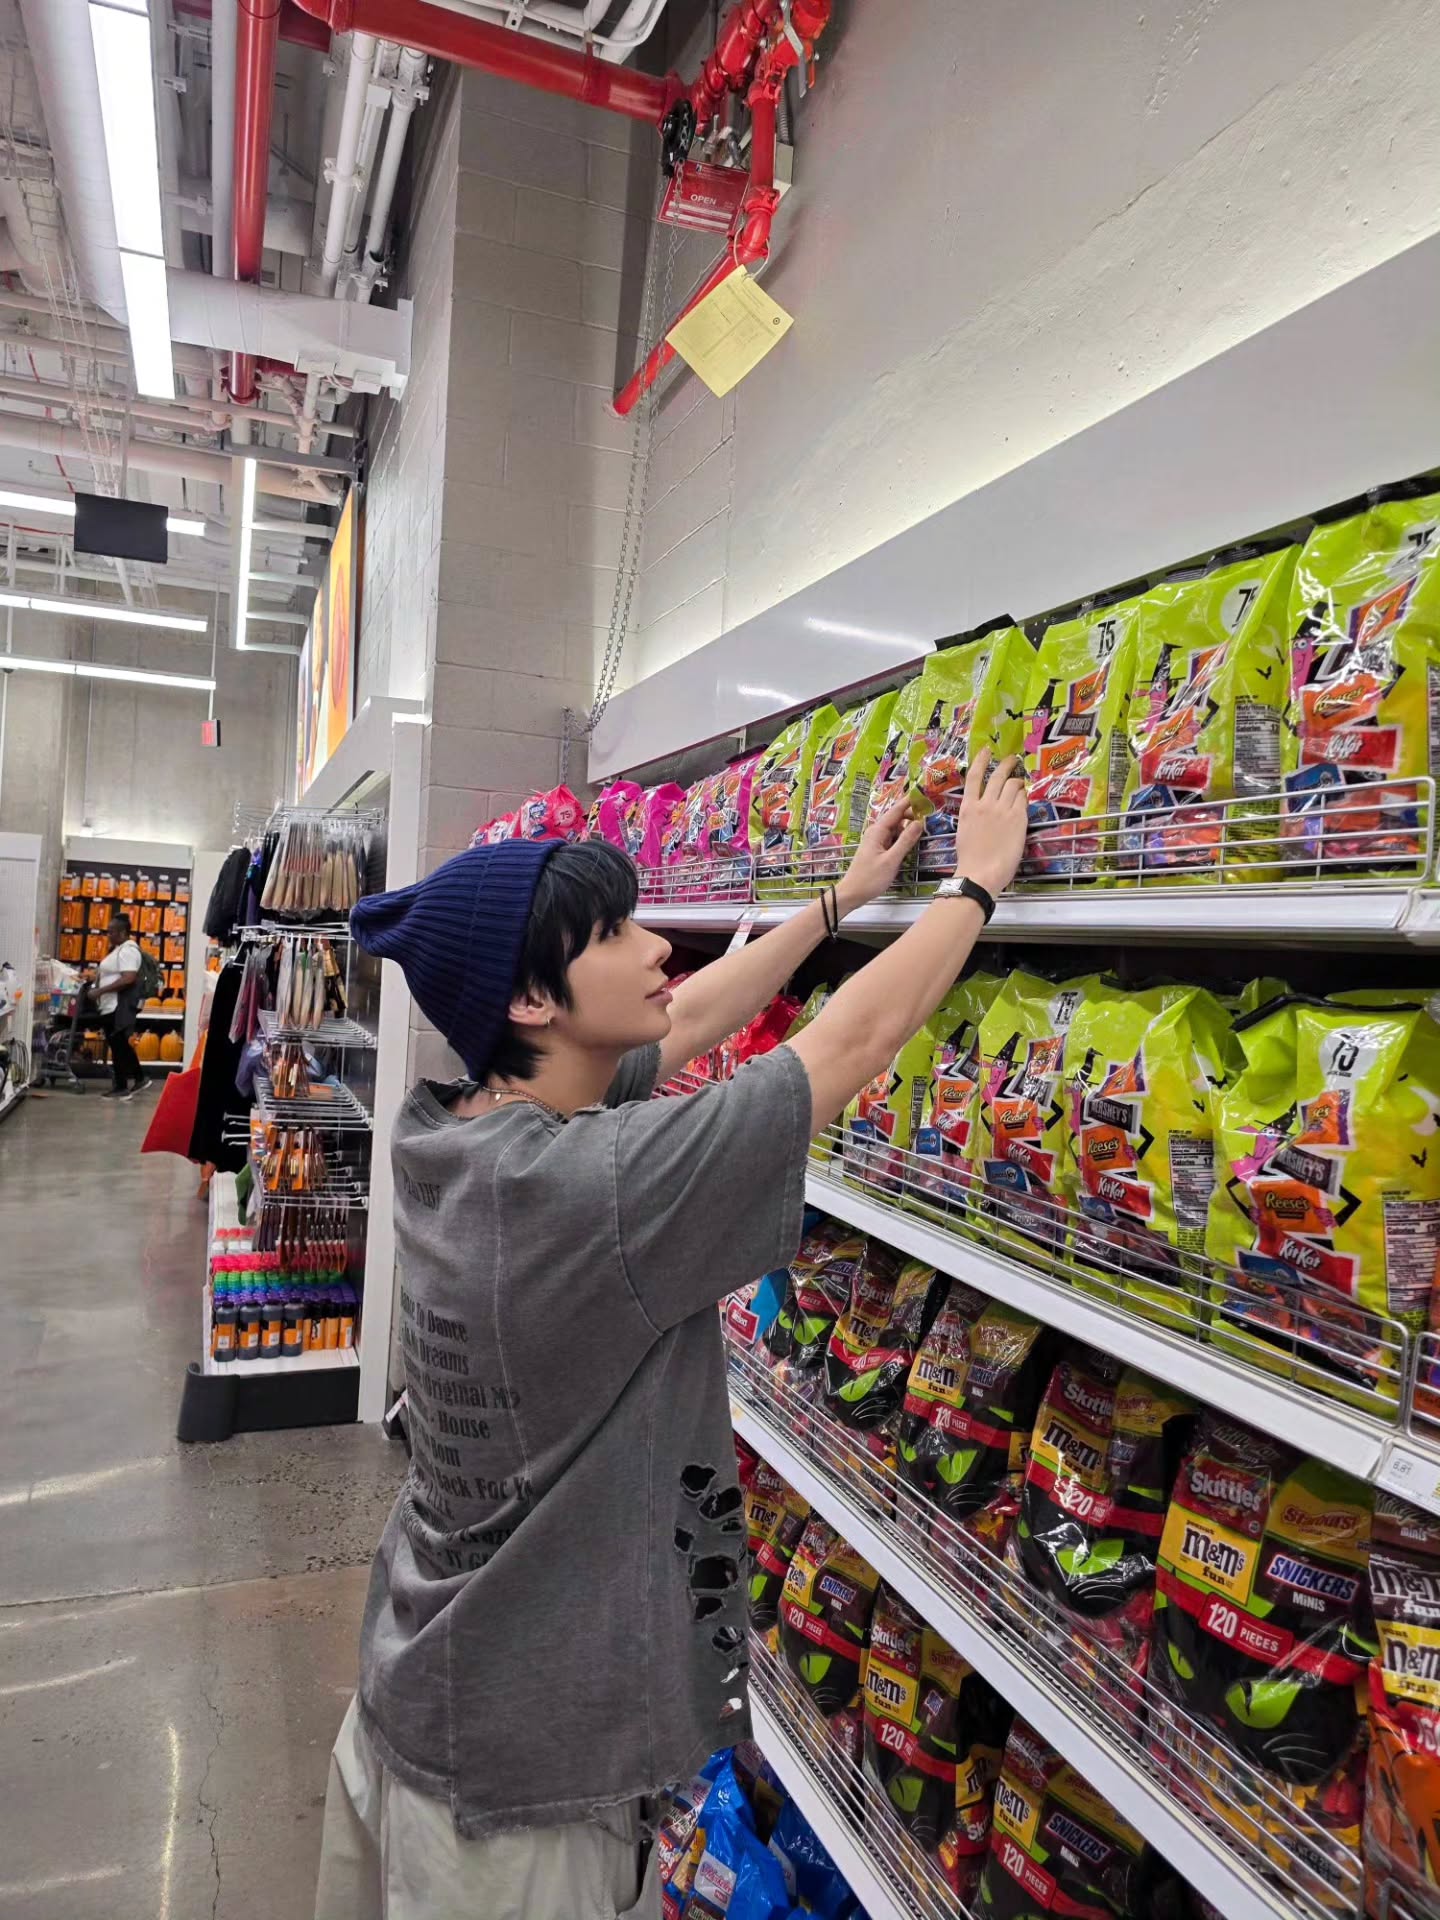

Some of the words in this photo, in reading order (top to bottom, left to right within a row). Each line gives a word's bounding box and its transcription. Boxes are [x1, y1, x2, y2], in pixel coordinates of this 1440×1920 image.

[690, 194, 717, 205] OPEN
[1155, 760, 1187, 781] KitKat
[559, 810, 572, 820] 75
[1090, 1099, 1128, 1123] HERSHEY'S
[1087, 1137, 1119, 1154] Reese's
[1279, 1150, 1326, 1181] HERSHEY'S
[1096, 1176, 1126, 1200] KitKat
[1265, 1192, 1310, 1210] Reese's
[1279, 1238, 1321, 1269] KitKat
[427, 1309, 469, 1343] Dance
[420, 1336, 469, 1376] Dreams
[423, 1372, 487, 1409] Original
[928, 1381, 946, 1395] fun
[437, 1410, 491, 1439] House
[935, 1406, 950, 1429] 120
[952, 1417, 968, 1432] PIECES
[434, 1467, 473, 1498] Back
[1190, 1471, 1262, 1512] Skittles
[1283, 1506, 1360, 1530] Starburst
[1400, 1526, 1427, 1542] minis
[1202, 1566, 1226, 1586] fun
[1270, 1556, 1355, 1600] SNICKERS
[823, 1577, 855, 1603] SNICKERS
[788, 1606, 805, 1629] 120
[1206, 1603, 1238, 1639] 120
[1240, 1628, 1279, 1652] PIECES
[870, 1624, 912, 1656] Skittles
[874, 1694, 892, 1712] fun
[880, 1722, 906, 1751] 120
[998, 1809, 1016, 1828] fun
[1050, 1815, 1107, 1861] SNICKERS
[1002, 1842, 1025, 1877] 120
[1024, 1869, 1049, 1896] PIECES
